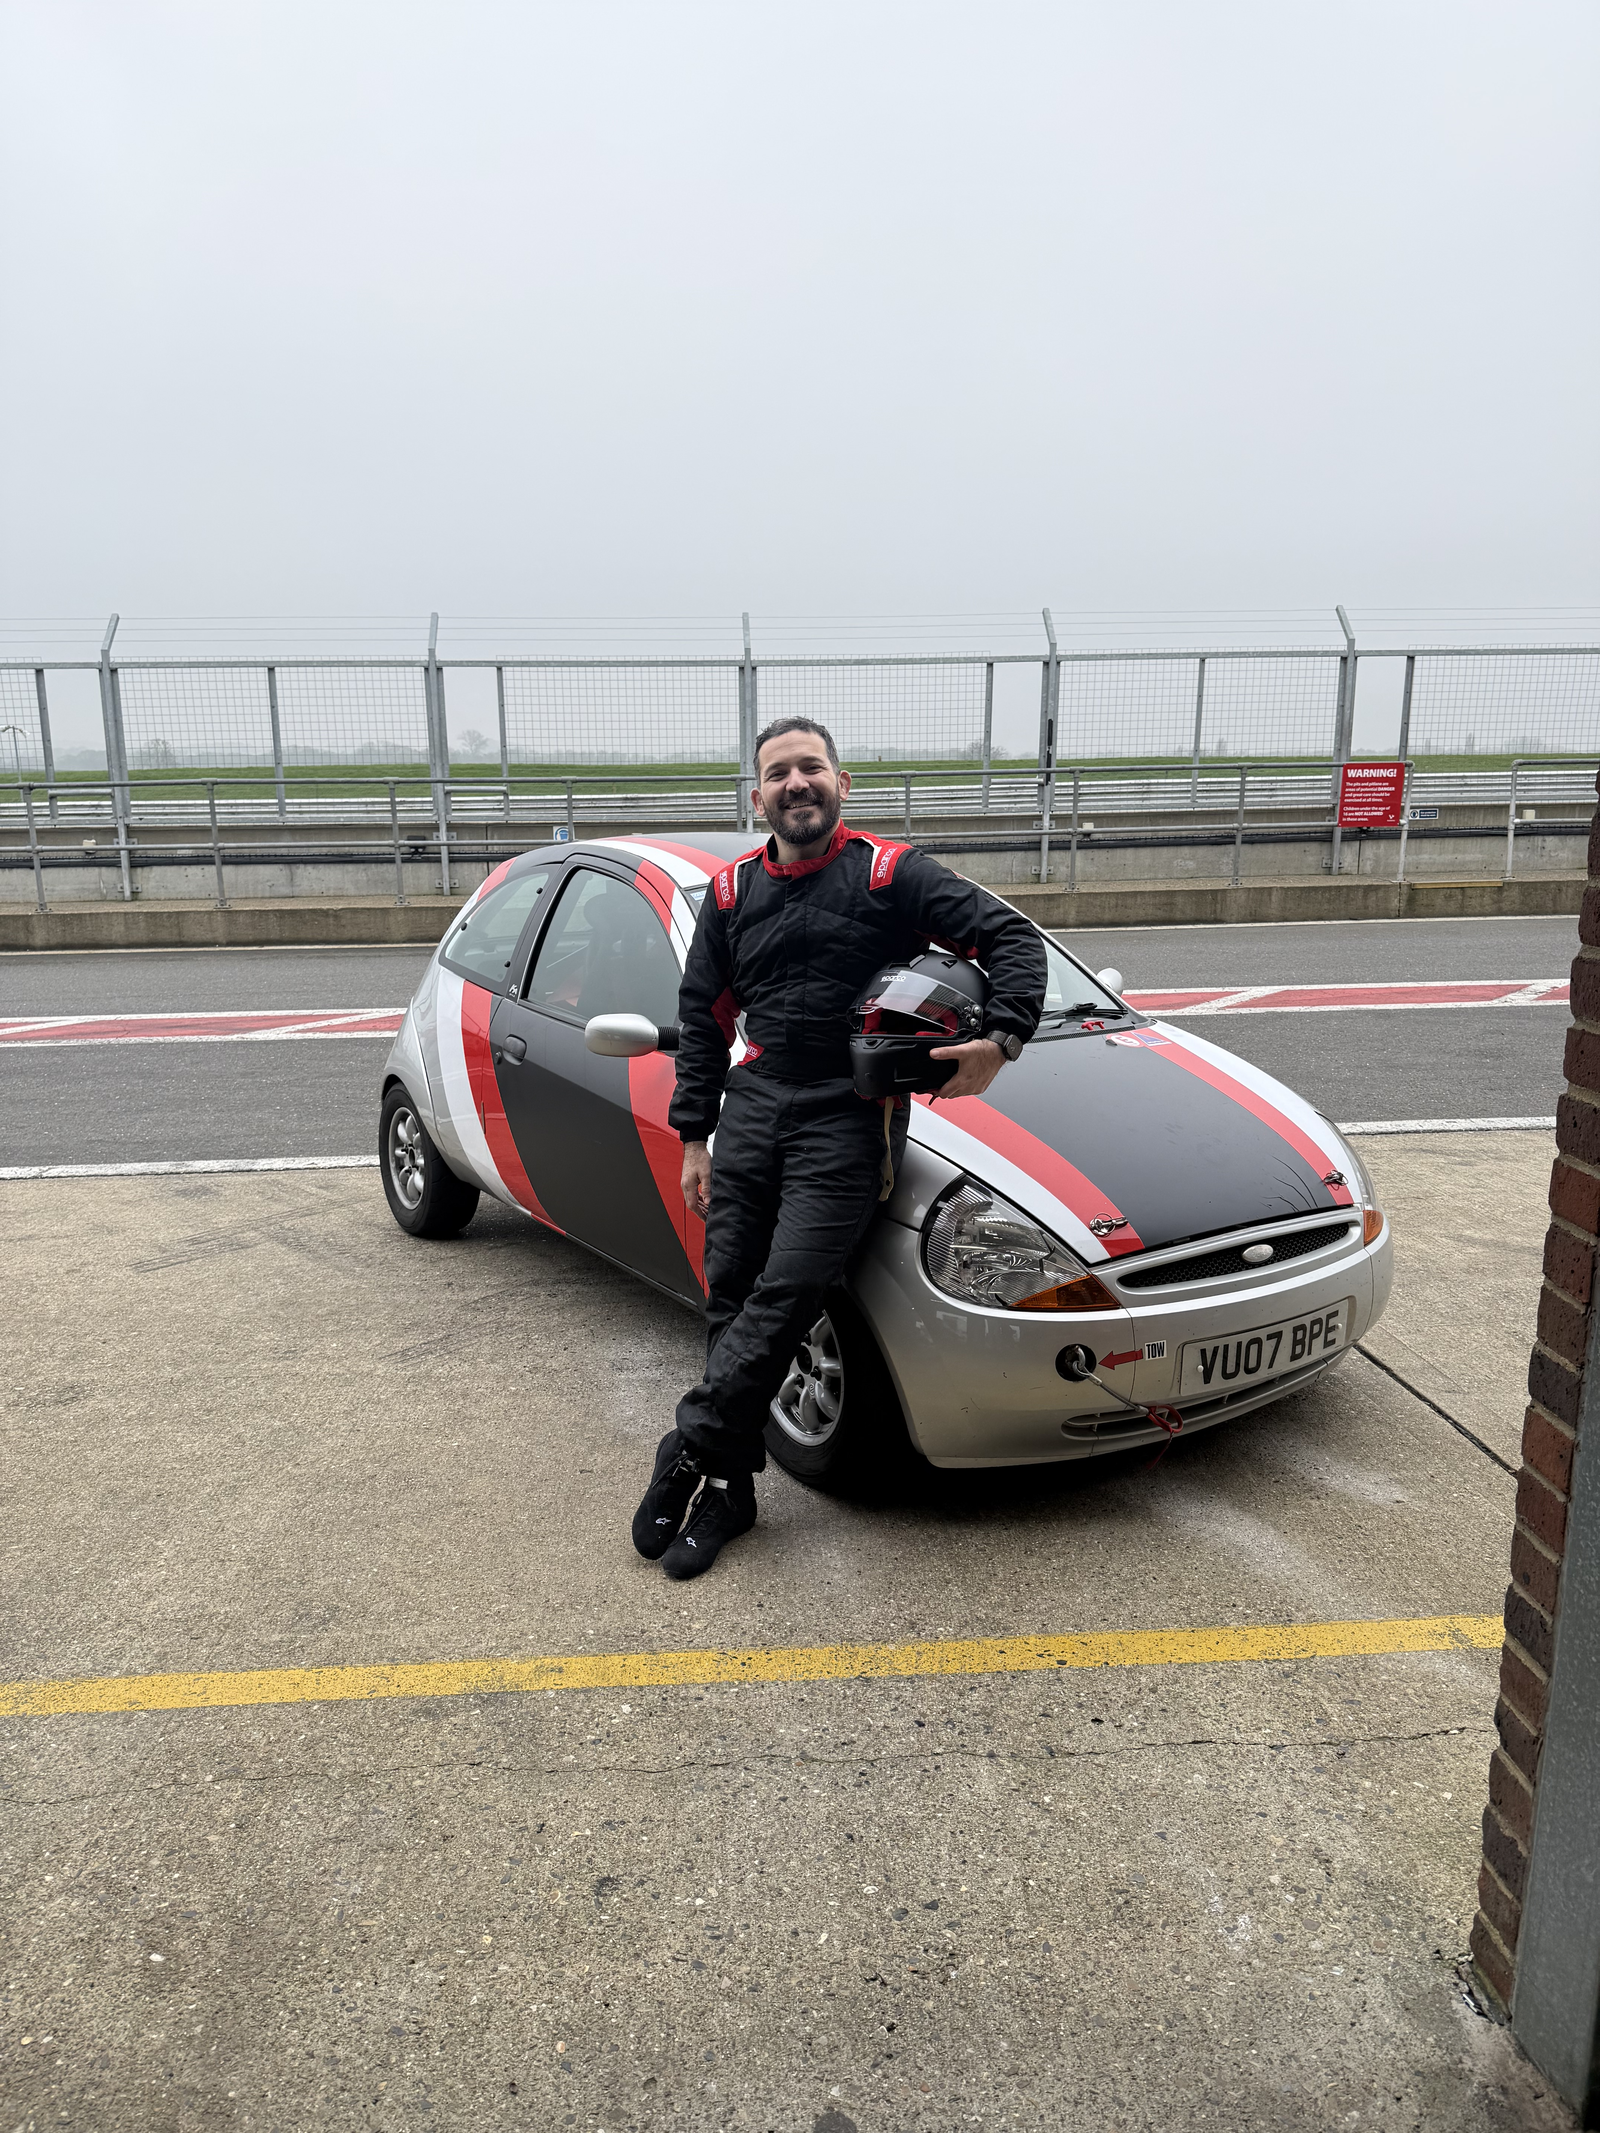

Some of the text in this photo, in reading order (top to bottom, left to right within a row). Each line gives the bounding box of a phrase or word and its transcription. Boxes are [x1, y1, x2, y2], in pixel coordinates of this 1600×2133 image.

[1347, 769, 1397, 777] WARNING!
[877, 847, 898, 879] sparco
[1146, 1341, 1165, 1359] TOW
[1200, 1310, 1340, 1385] VU07 BPE
